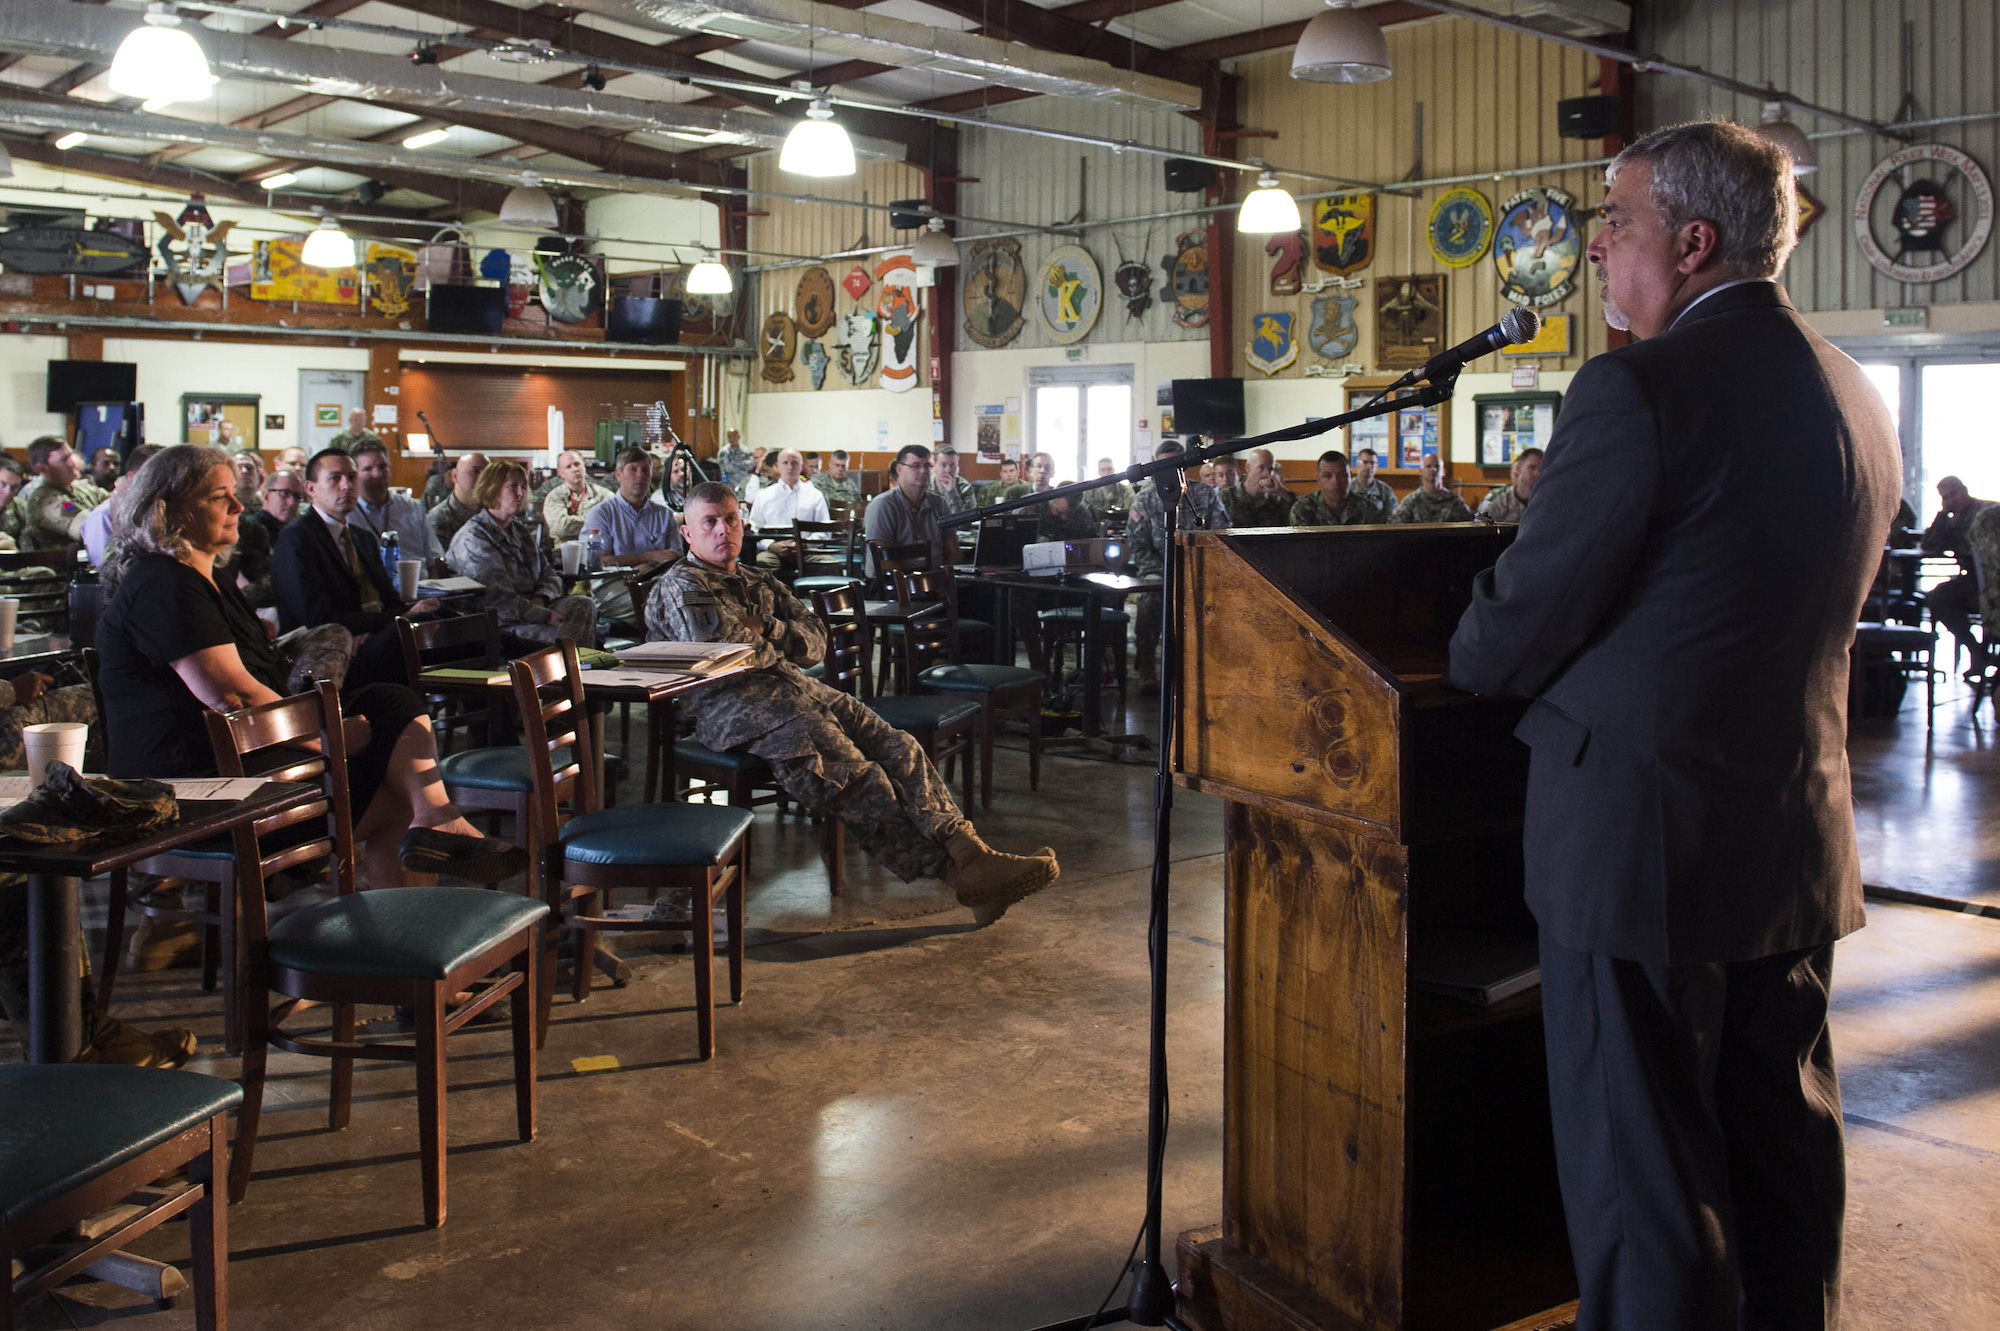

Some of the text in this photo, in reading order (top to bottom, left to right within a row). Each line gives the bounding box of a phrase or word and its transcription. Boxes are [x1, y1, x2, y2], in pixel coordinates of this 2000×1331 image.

[1503, 188, 1536, 211] PATRO
[1546, 188, 1569, 206] FIVE
[1055, 280, 1081, 323] K
[1507, 285, 1567, 307] MAD FOXES
